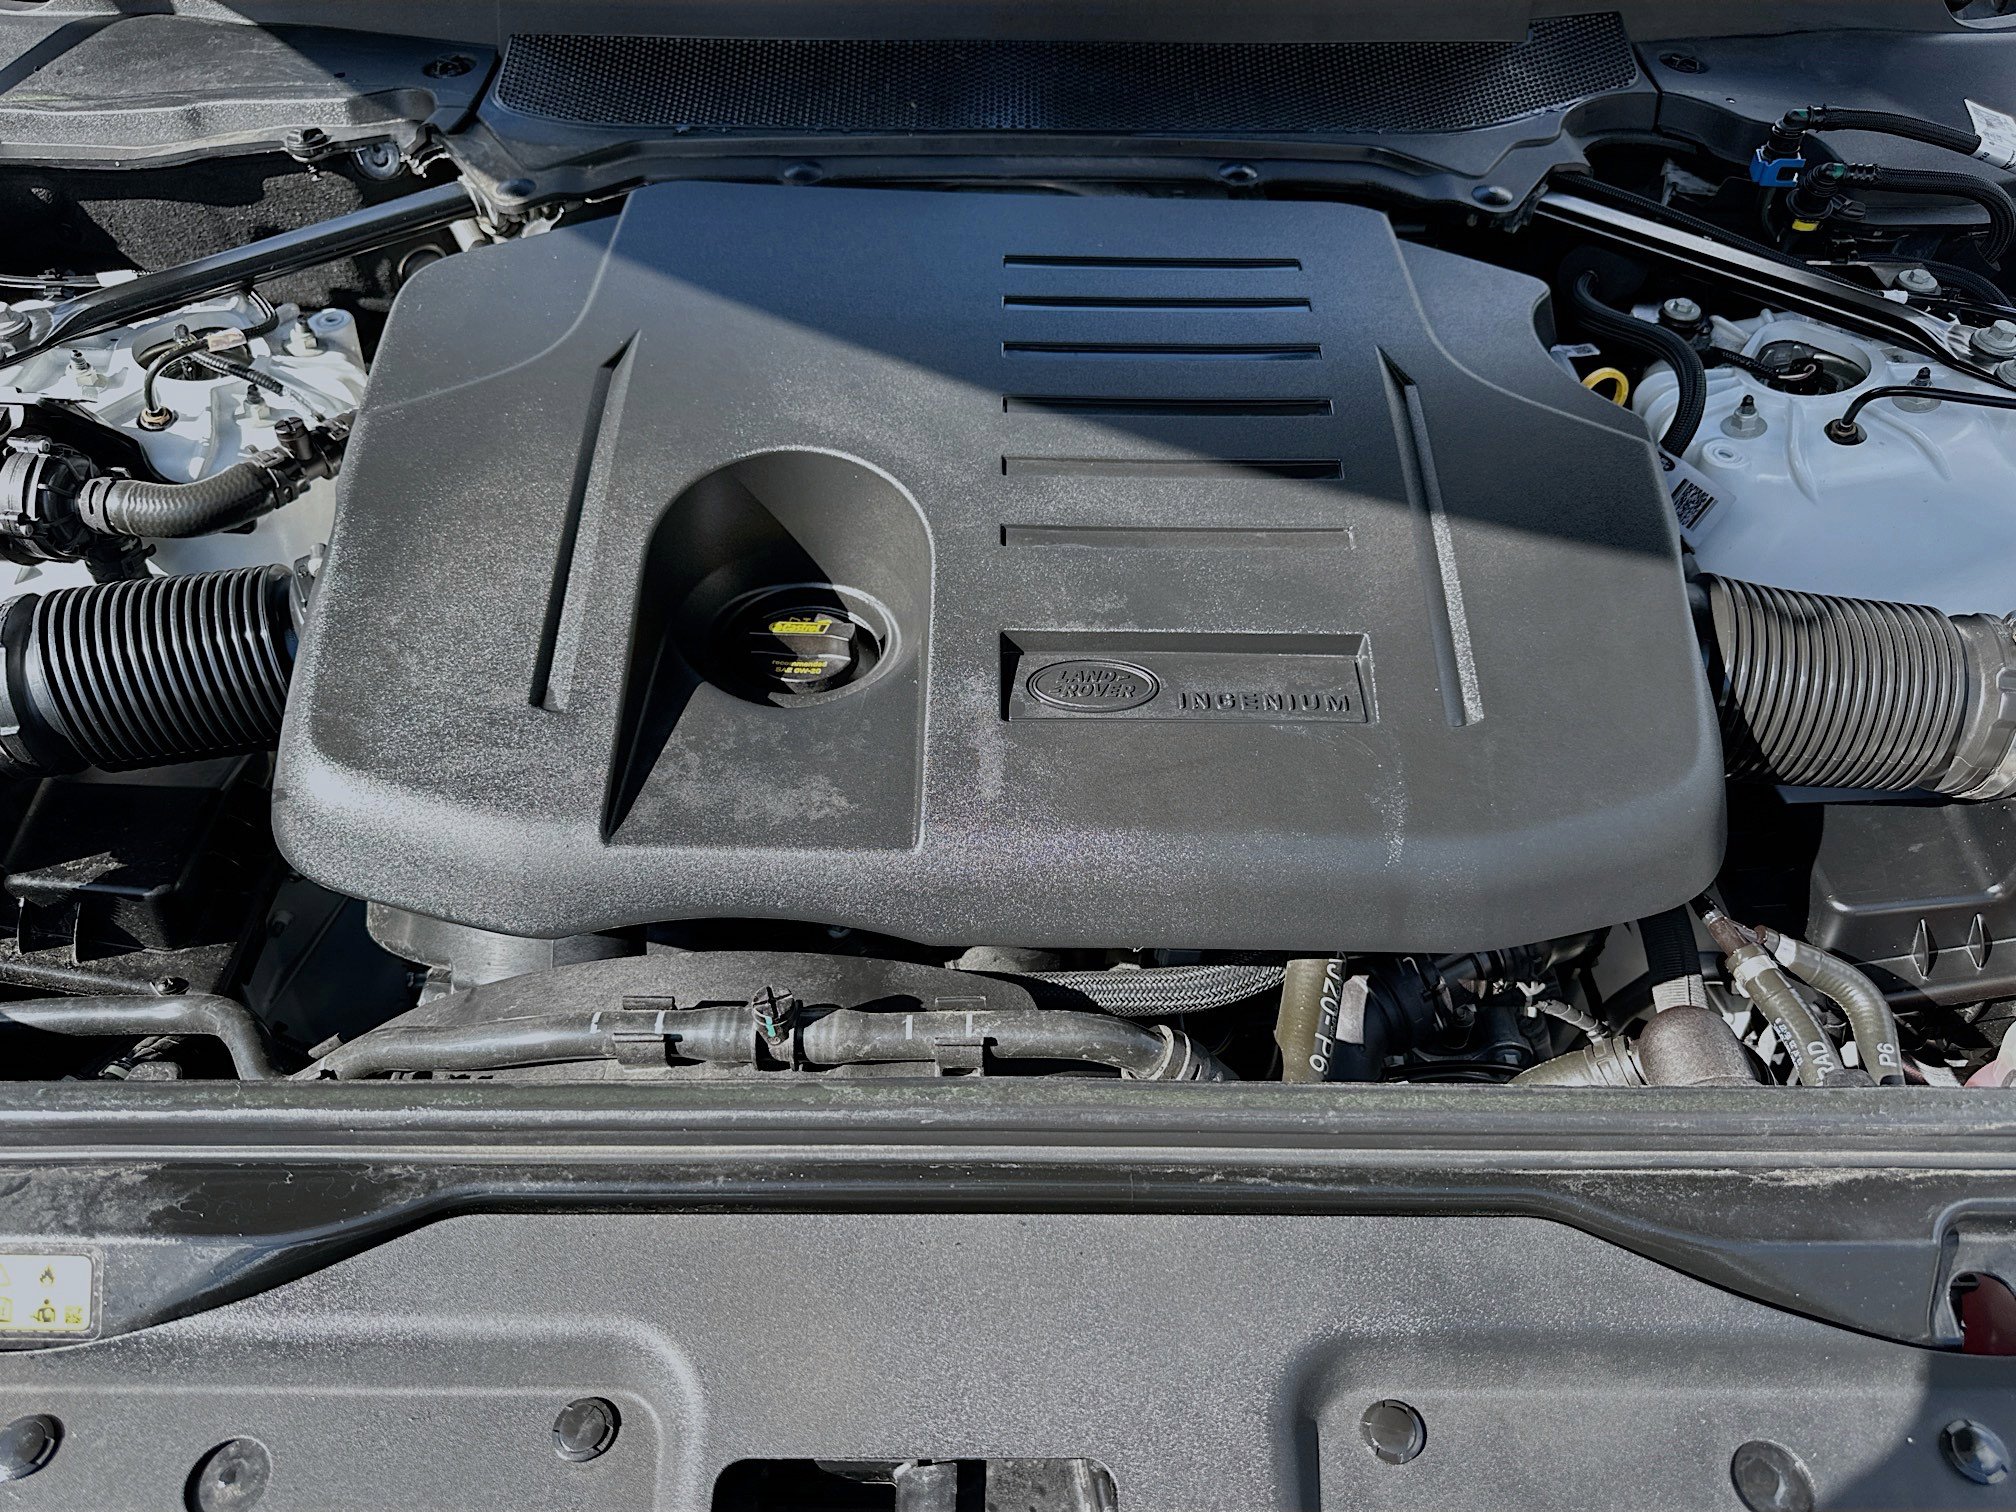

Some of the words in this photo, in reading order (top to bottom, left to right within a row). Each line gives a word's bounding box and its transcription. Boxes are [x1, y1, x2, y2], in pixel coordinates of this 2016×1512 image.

[1056, 670, 1117, 684] LAND
[1060, 683, 1136, 698] ROVER
[1178, 691, 1350, 712] INGENIUM
[1876, 1042, 1898, 1067] P6
